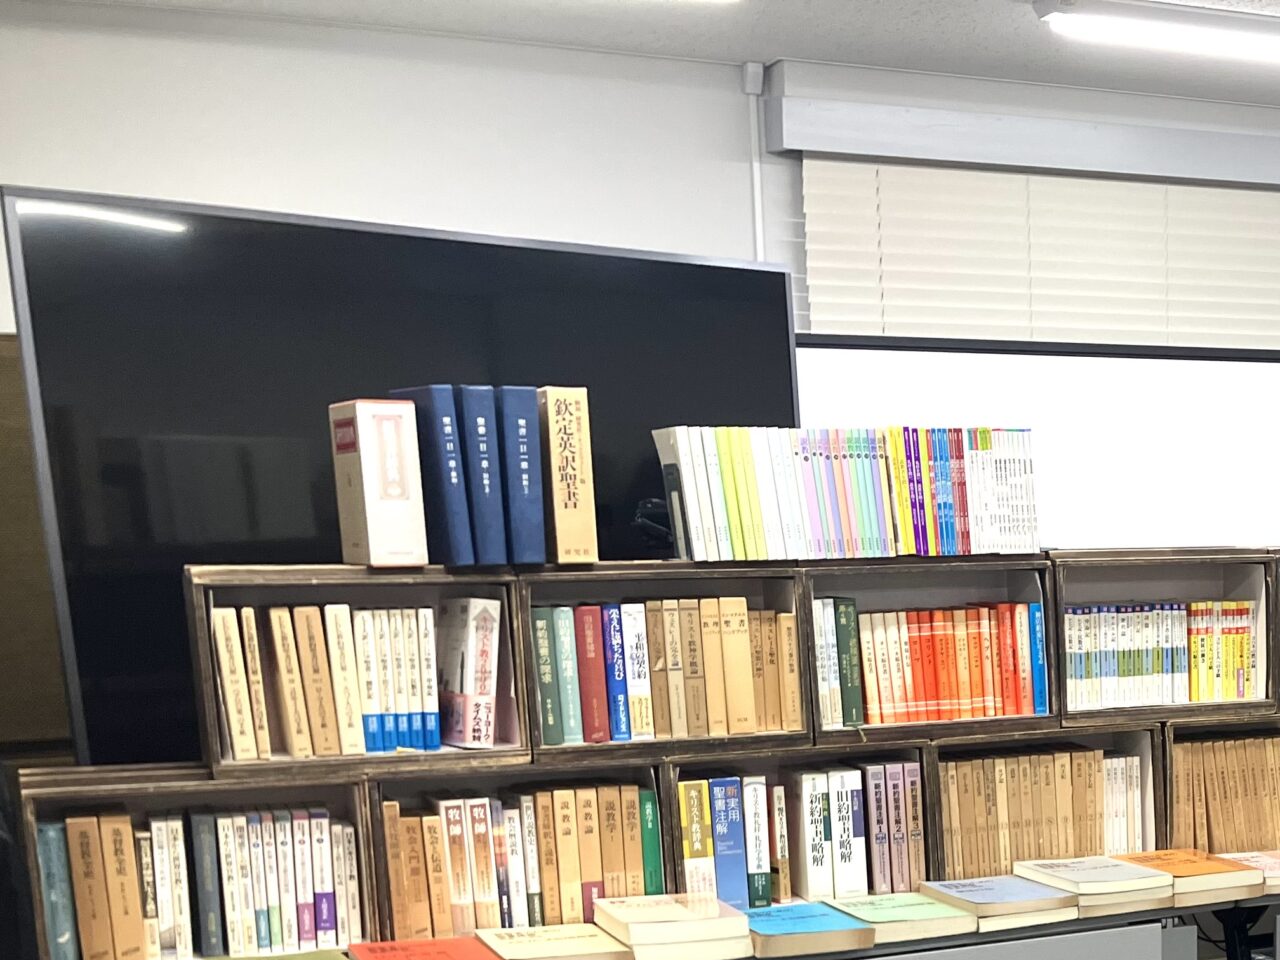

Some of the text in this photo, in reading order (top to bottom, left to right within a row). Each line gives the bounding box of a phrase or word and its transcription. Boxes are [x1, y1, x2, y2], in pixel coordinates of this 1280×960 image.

[554, 398, 578, 510] 欽定英訳聖書
[687, 613, 698, 675] キリスト教神学概論
[448, 808, 462, 835] 牧師
[472, 807, 486, 835] 牧師
[560, 801, 572, 836] 説教論
[583, 800, 594, 834] 説教論
[605, 800, 616, 833] 説教学
[626, 799, 637, 832] 説教学
[713, 787, 729, 836] 聖書注解
[836, 790, 853, 863] 旧約聖書略解
[809, 793, 824, 867] 新約聖書略解
